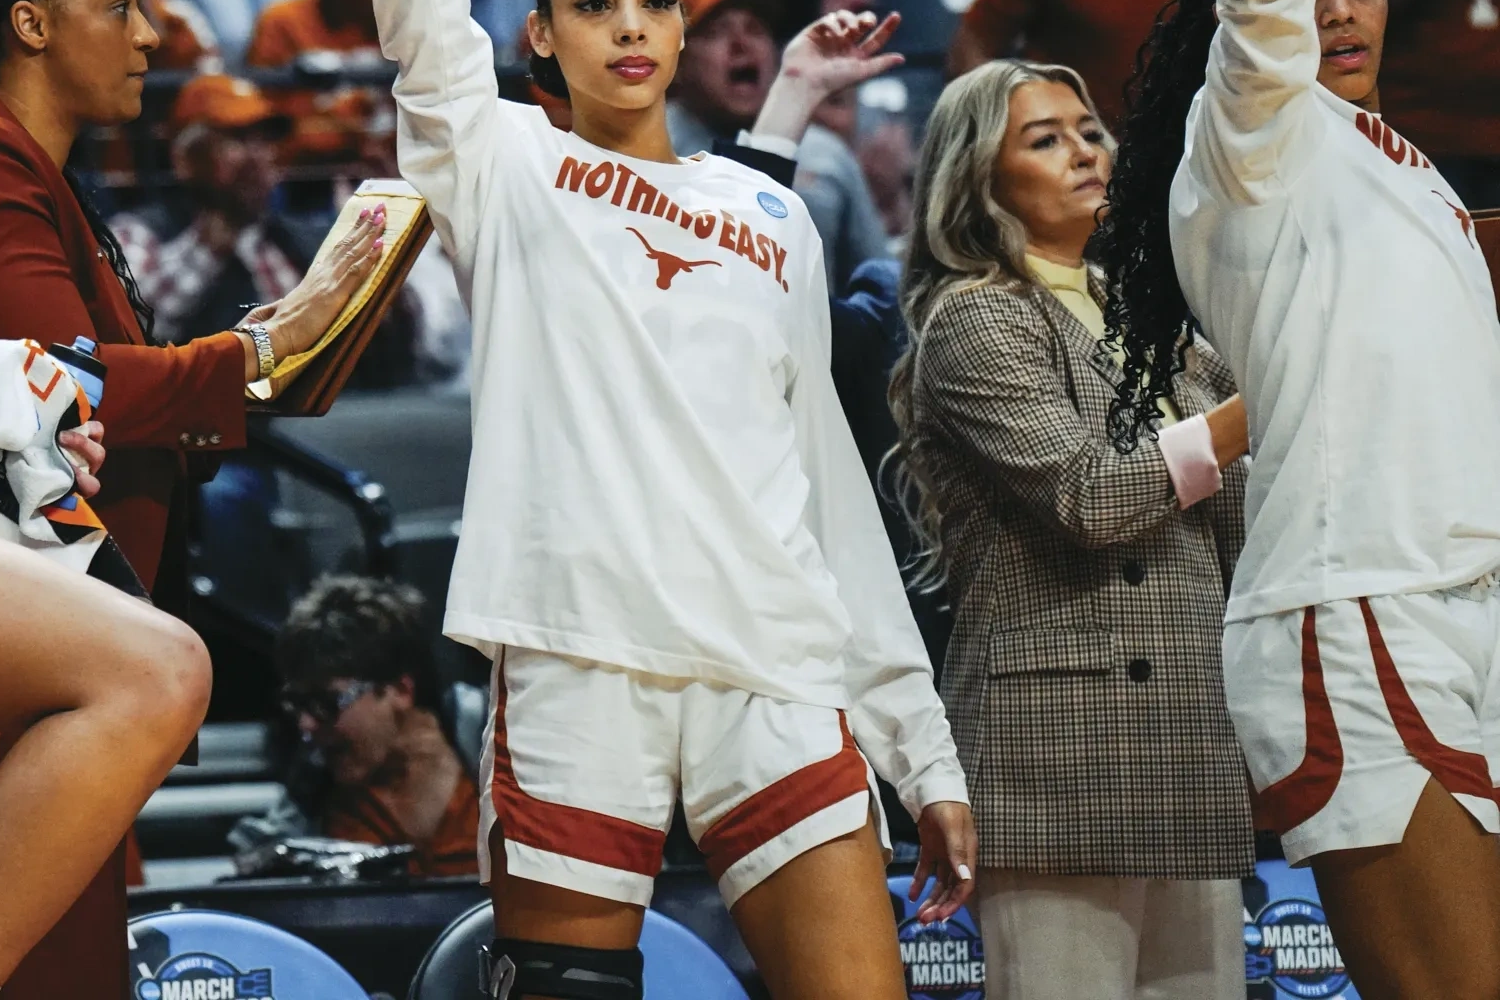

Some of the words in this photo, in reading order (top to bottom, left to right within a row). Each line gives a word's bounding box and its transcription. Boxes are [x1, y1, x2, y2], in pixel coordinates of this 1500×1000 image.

[555, 156, 716, 239] NOTHING
[719, 208, 789, 293] EASY.
[1263, 924, 1334, 948] MARCH
[900, 940, 969, 963] MARCH
[1276, 945, 1345, 970] MADN
[912, 961, 986, 986] MADNE
[162, 977, 234, 1000] MARCH
